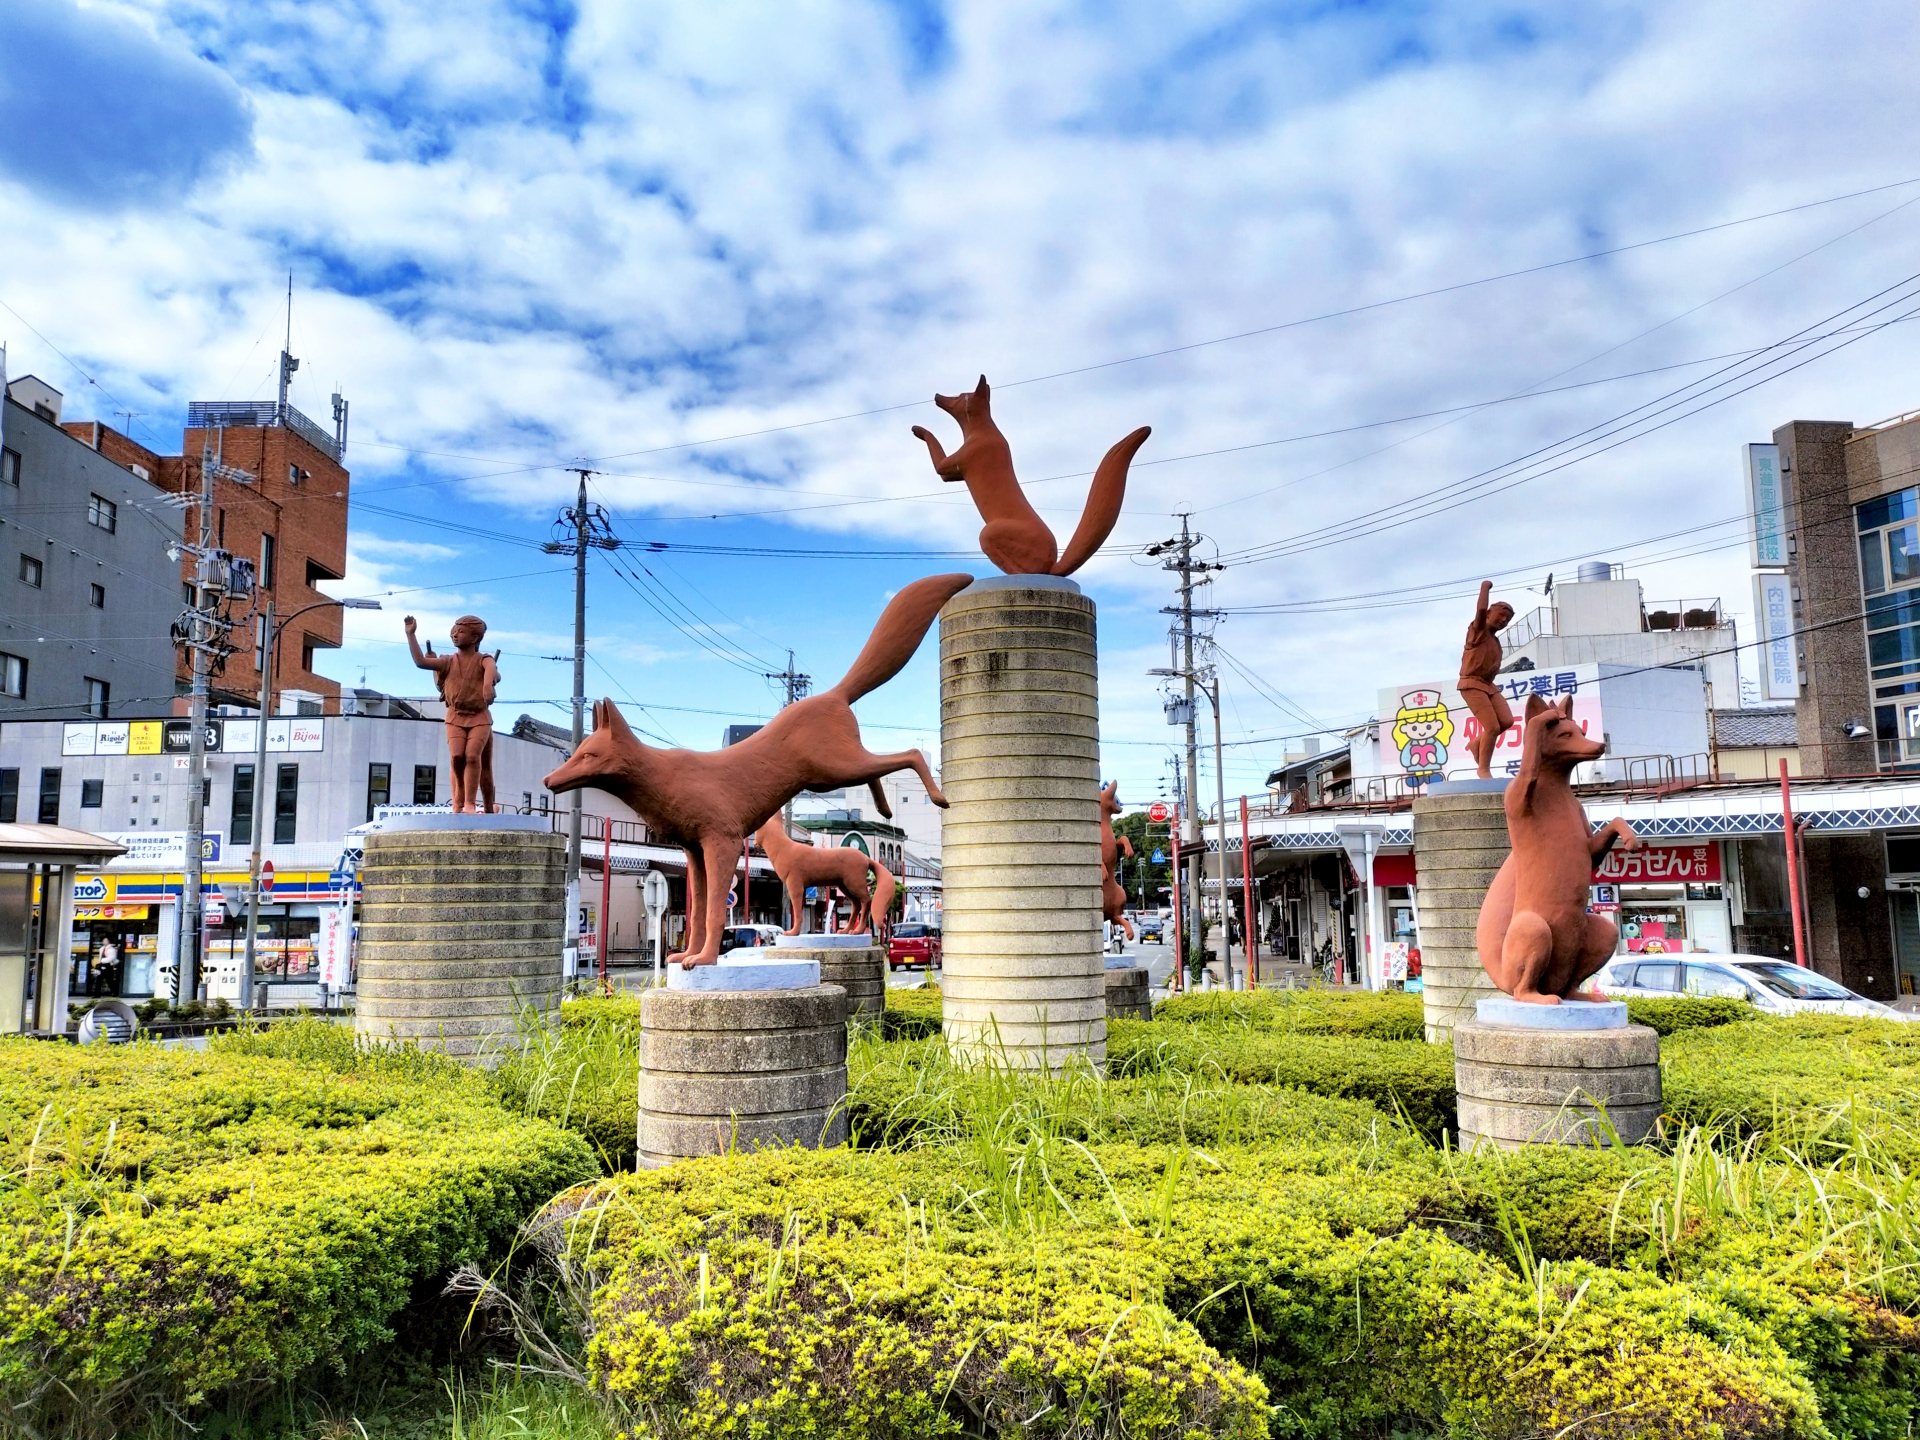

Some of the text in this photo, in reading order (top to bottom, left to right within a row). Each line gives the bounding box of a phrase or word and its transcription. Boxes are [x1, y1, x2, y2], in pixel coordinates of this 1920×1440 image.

[1768, 586, 1792, 684] 内田歯科医院
[293, 731, 321, 743] Bijou
[1595, 849, 1692, 878] 処方せん
[1693, 848, 1708, 876] 受付
[1630, 914, 1677, 923] イセヤ薬局
